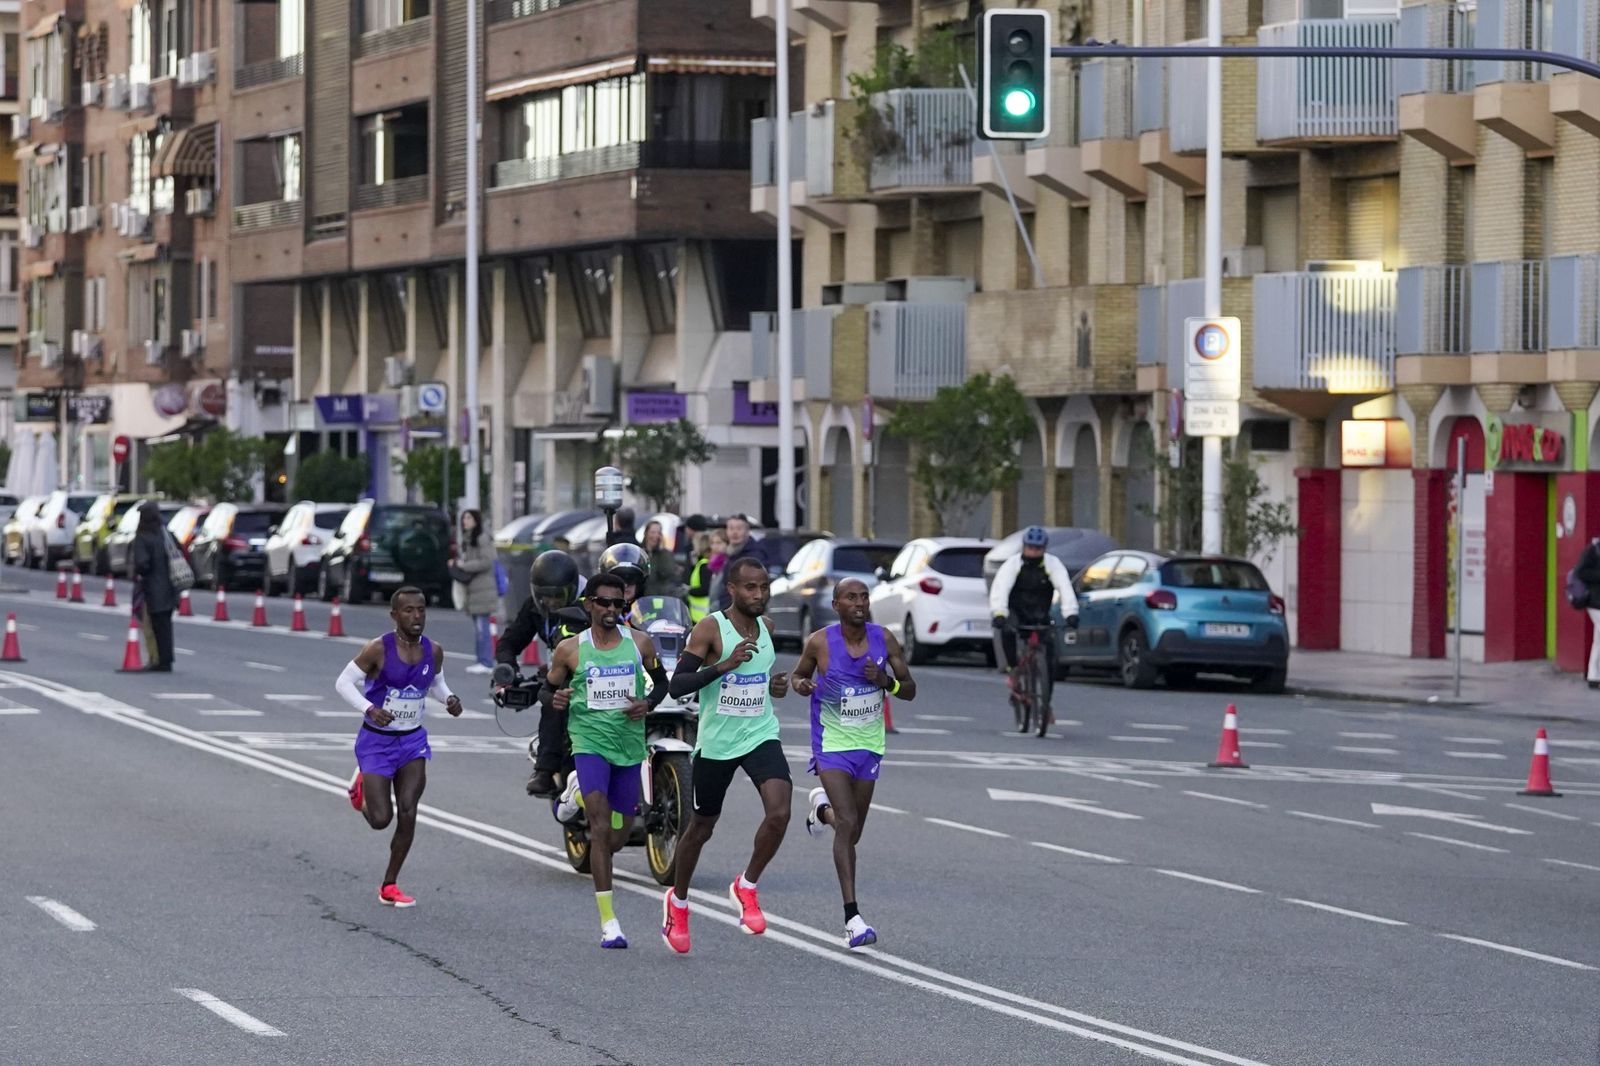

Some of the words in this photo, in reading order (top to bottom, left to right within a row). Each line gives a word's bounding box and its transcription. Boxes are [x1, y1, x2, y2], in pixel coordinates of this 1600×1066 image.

[601, 667, 630, 676] ZURICH
[739, 675, 763, 684] ZURICH
[593, 688, 630, 699] MESFUN
[857, 685, 880, 694] ZURIC
[720, 695, 764, 707] GODADAW
